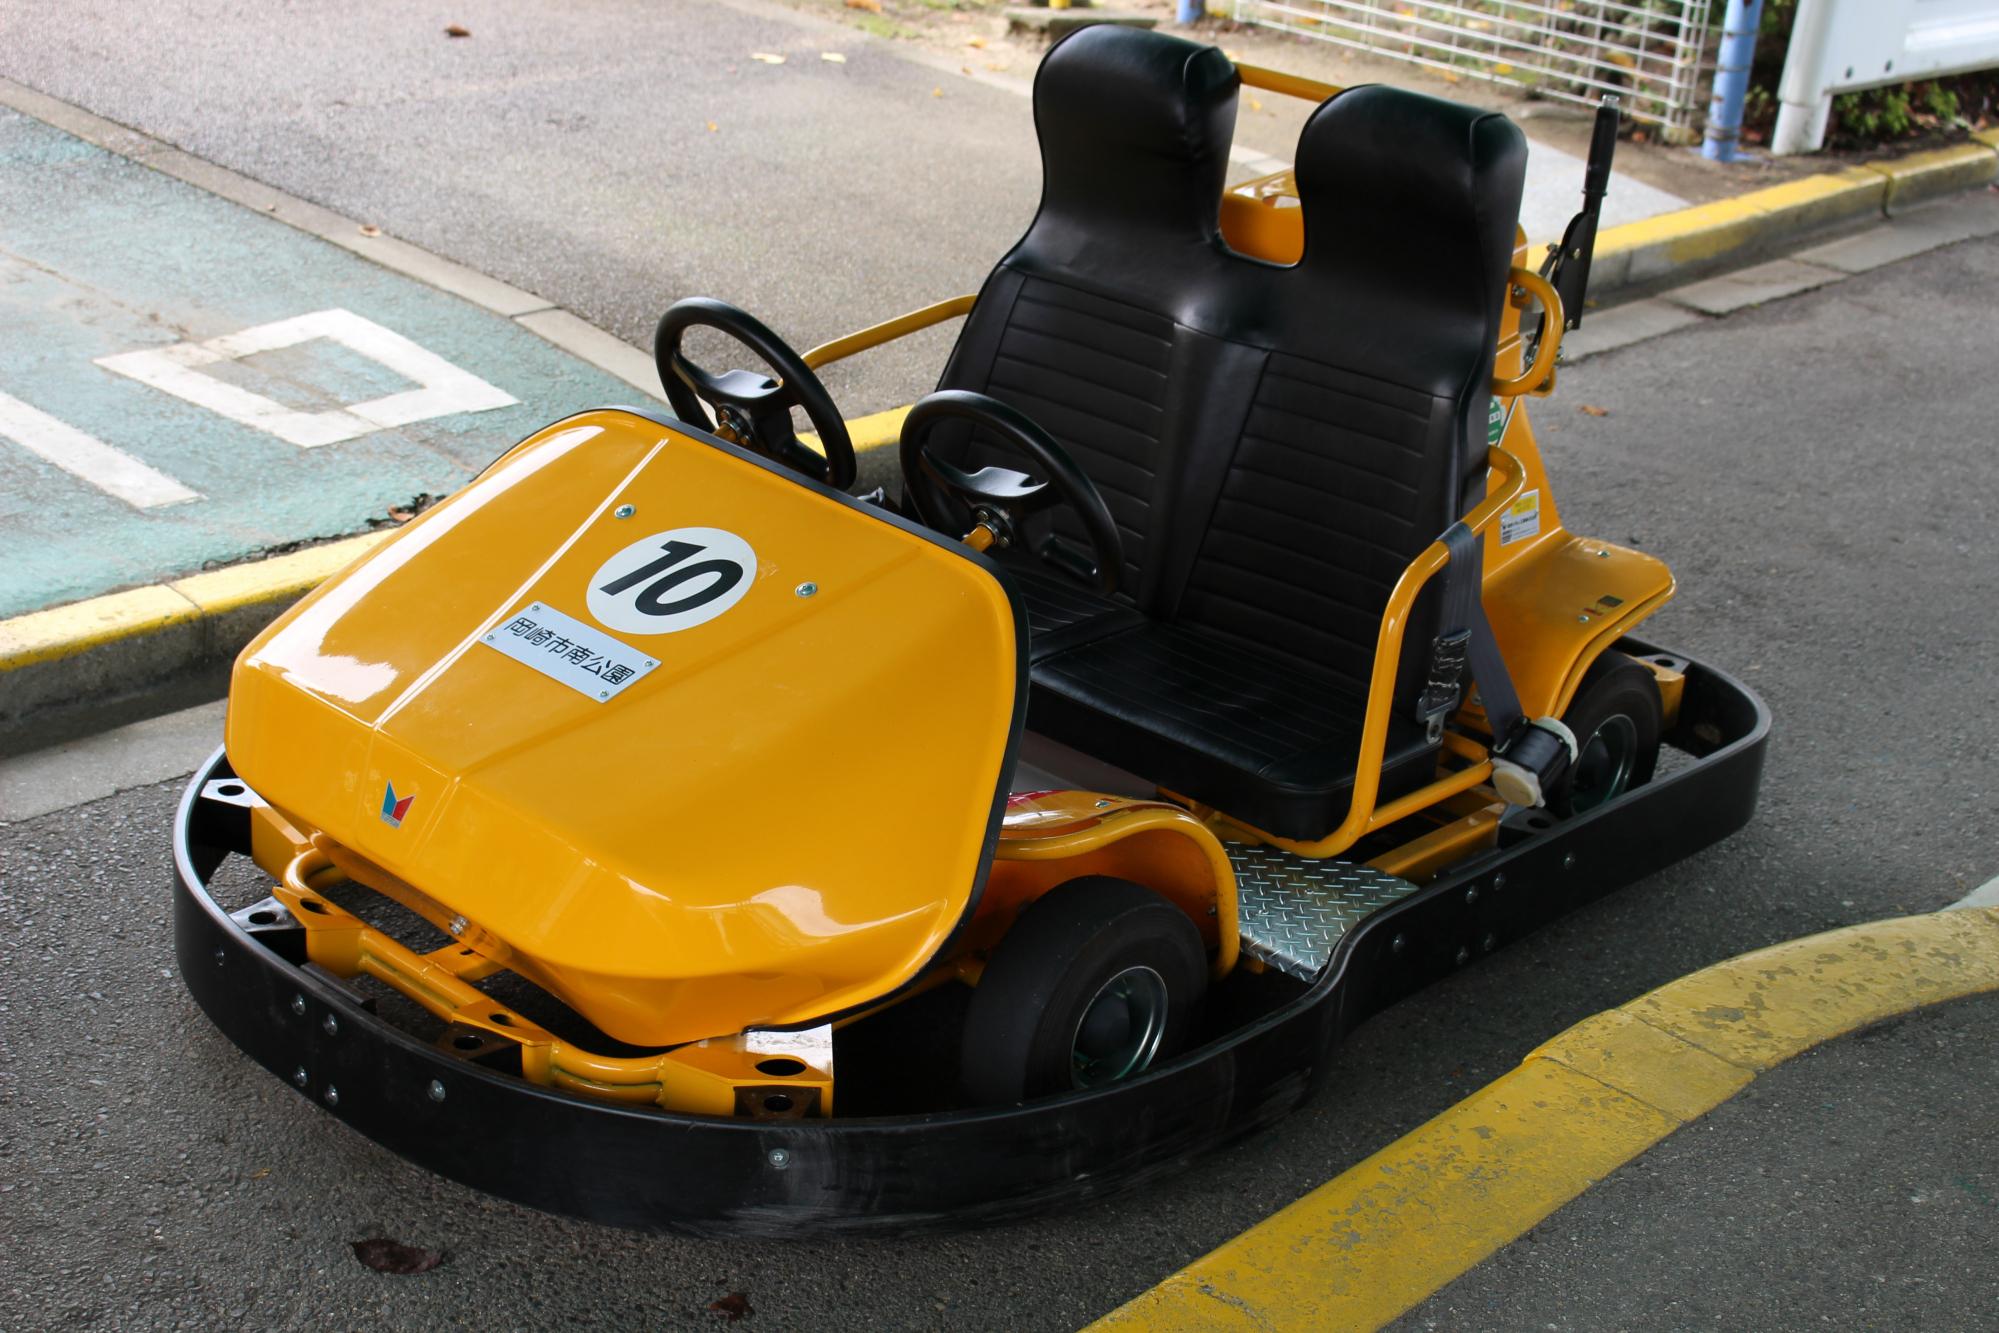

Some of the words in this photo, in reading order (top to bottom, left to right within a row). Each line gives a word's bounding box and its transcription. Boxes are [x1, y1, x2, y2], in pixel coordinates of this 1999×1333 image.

[599, 540, 744, 616] 10
[504, 617, 635, 685] 岡崎市南公園
